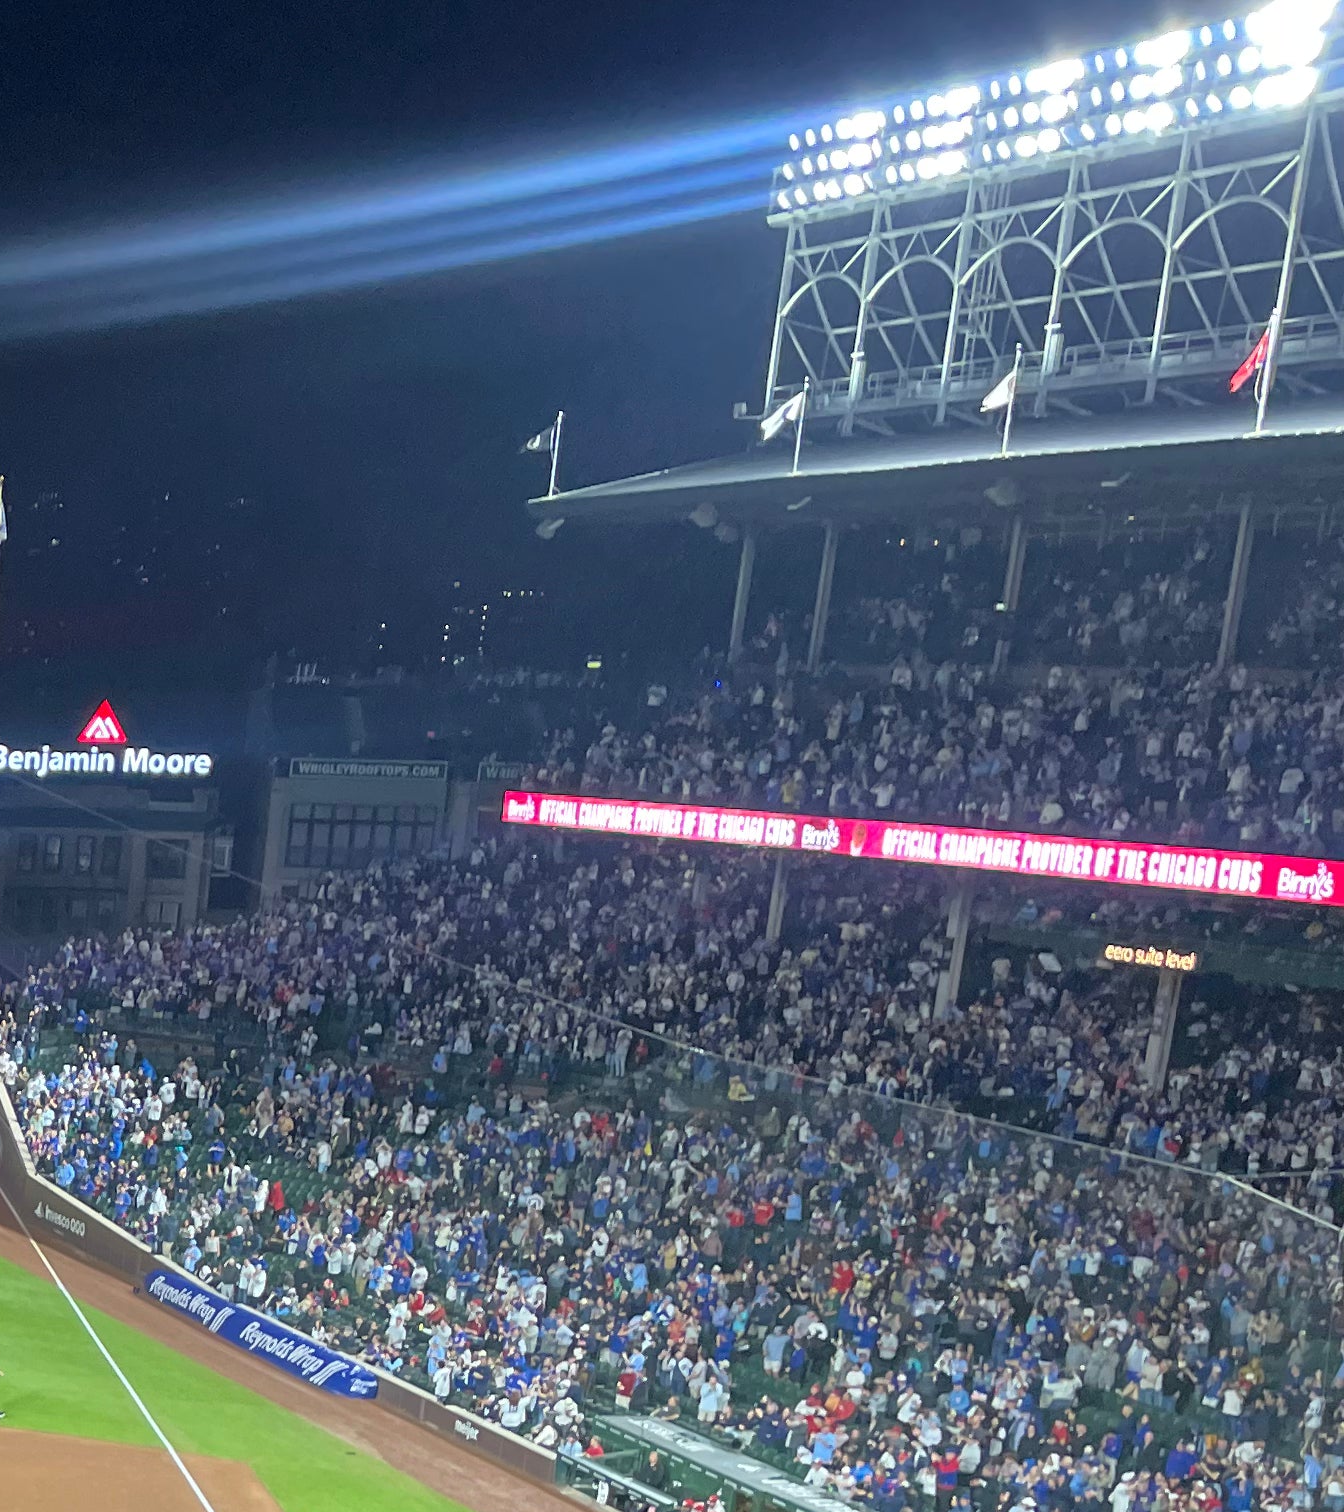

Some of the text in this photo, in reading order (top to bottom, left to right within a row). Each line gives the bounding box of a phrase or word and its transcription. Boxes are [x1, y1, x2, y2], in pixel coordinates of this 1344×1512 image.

[122, 746, 213, 775] Moore
[298, 762, 440, 777] WRIGLEYROOFTOPS.COM
[539, 799, 578, 825] OFFICIAL
[580, 803, 634, 831] CHAMPAGNE
[635, 807, 682, 836] PROVIDER
[683, 810, 698, 836] OF
[698, 811, 718, 838] THE
[718, 813, 765, 843] CHICAGO
[765, 818, 796, 846] CUBS
[882, 828, 1334, 900] OFFICIAL CHAMPAGNE PROVIDER OF THE CHICAGO CUBS Binny's
[1104, 944, 1196, 972] eero suite level
[148, 1275, 216, 1326] Reynolds Wrap
[239, 1320, 324, 1376] Reynolds Wrap
